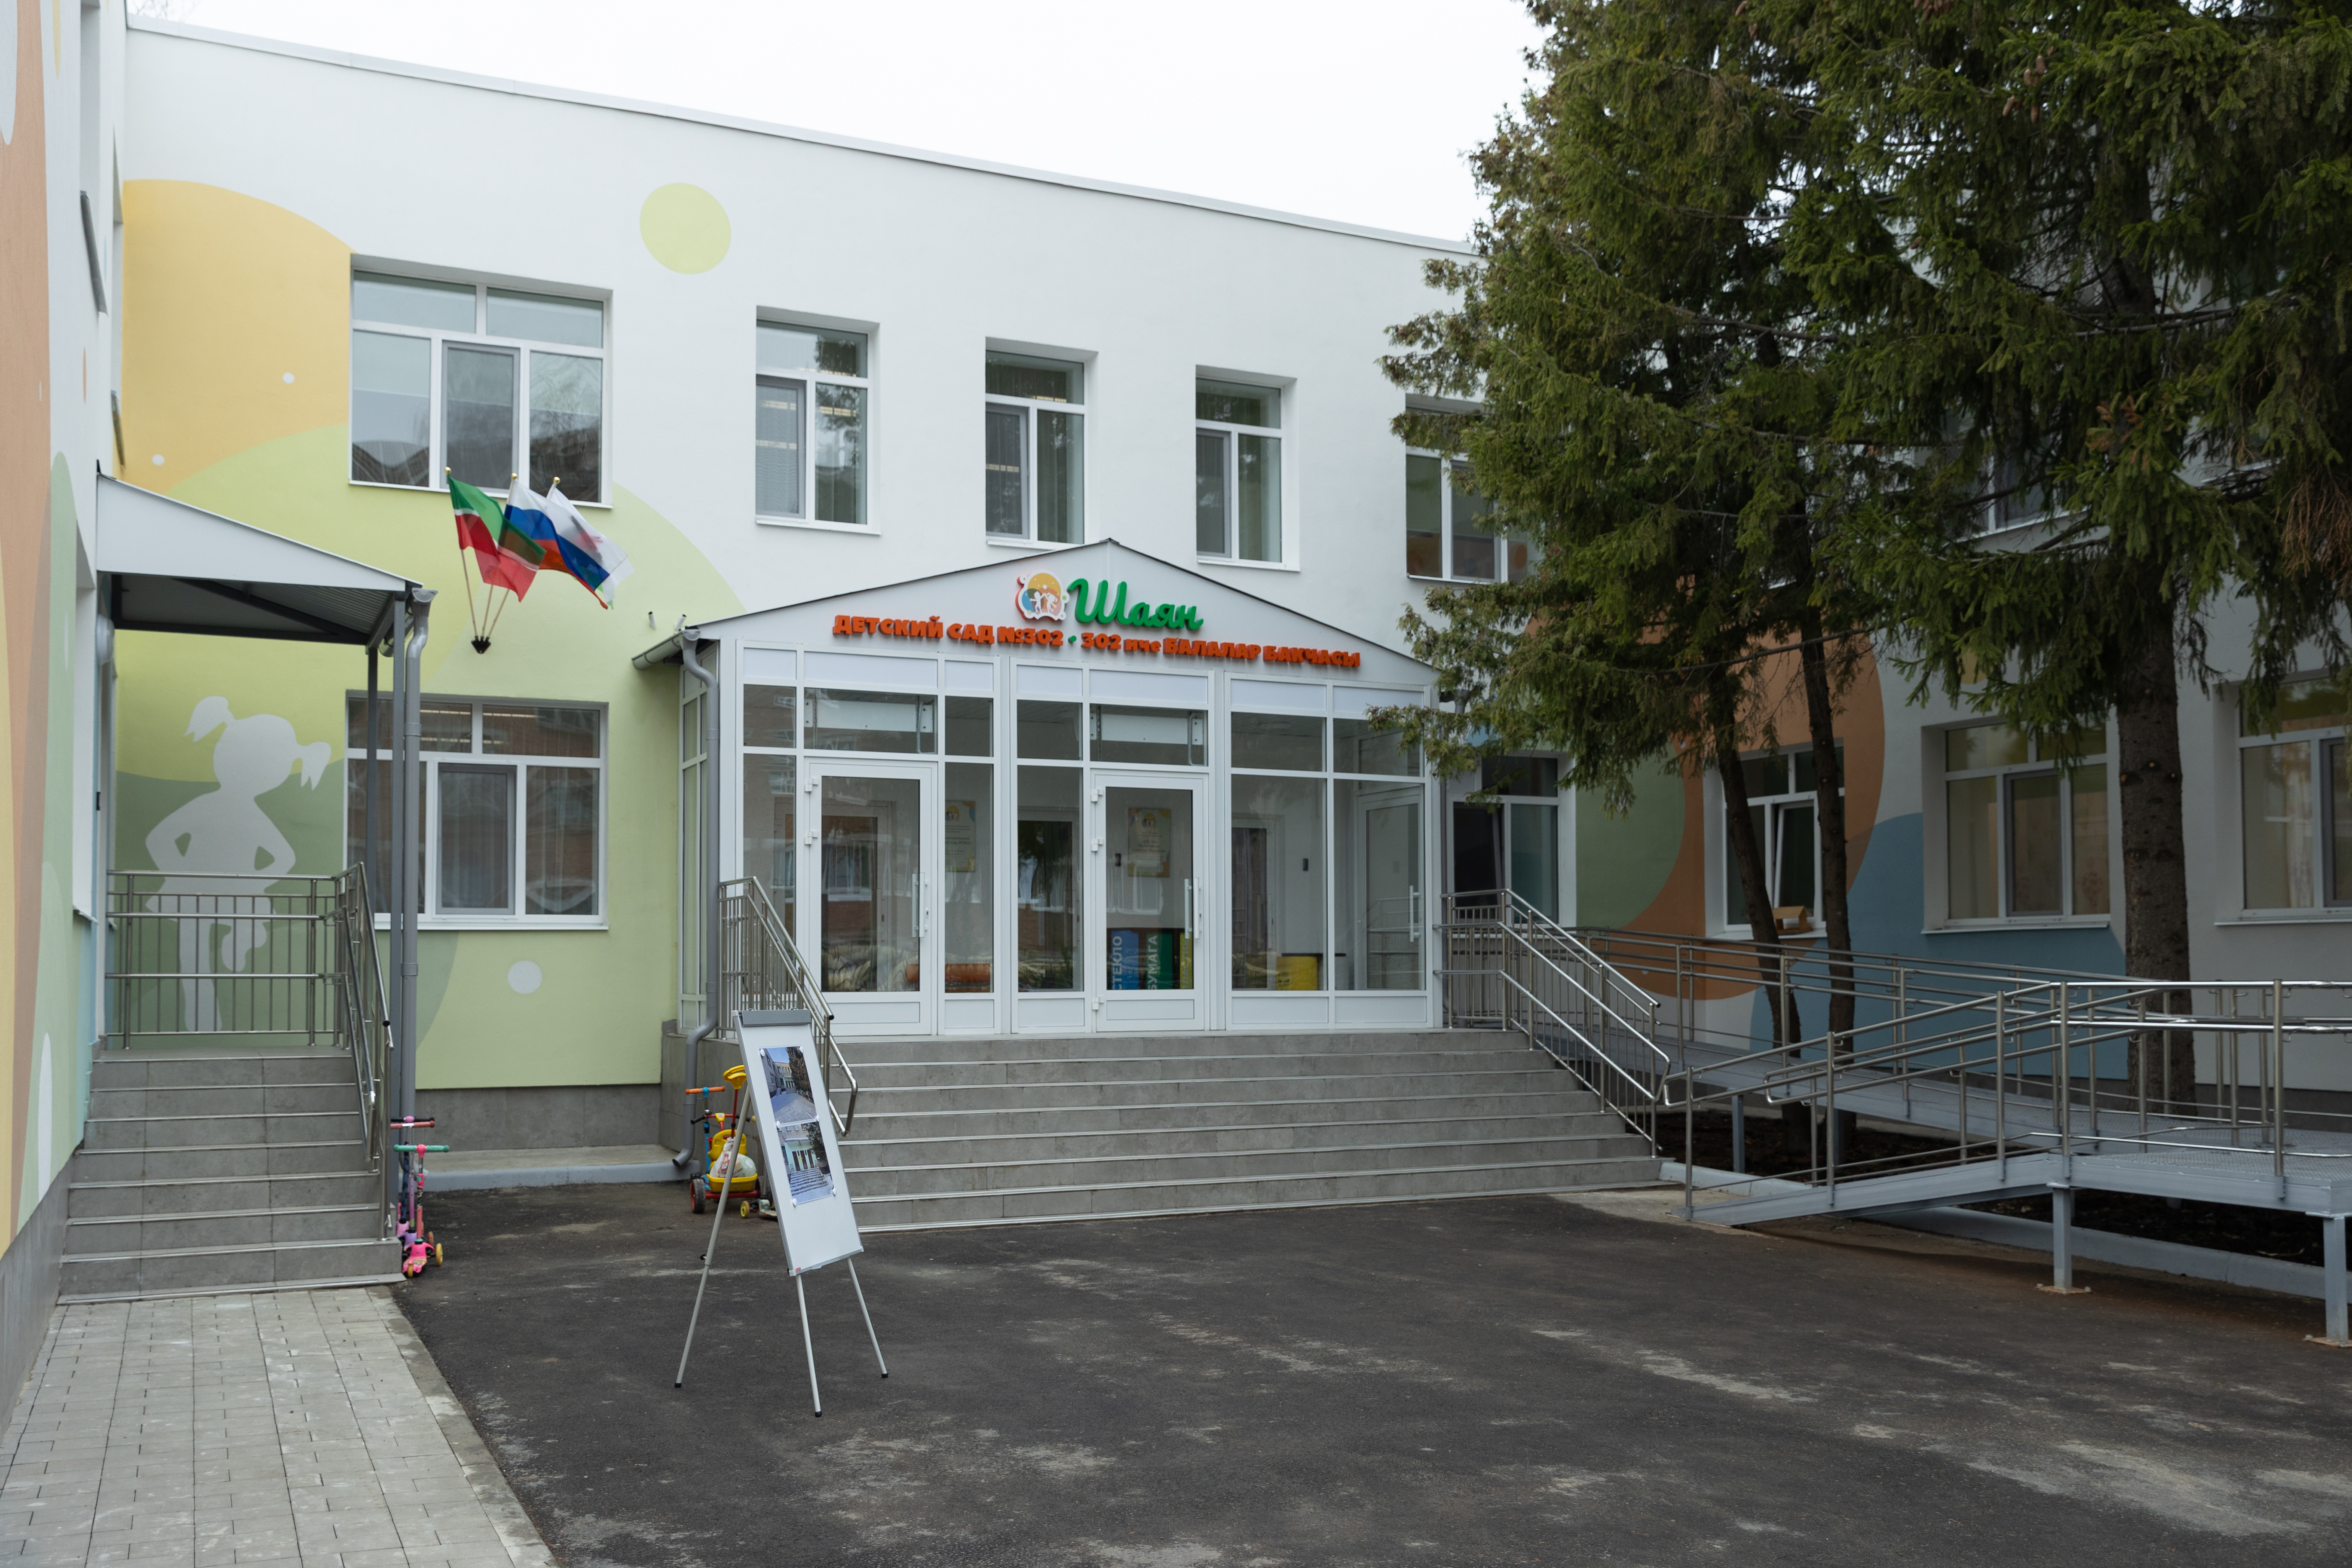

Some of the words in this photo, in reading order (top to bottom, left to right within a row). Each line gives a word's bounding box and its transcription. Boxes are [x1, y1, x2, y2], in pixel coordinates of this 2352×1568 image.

[1067, 578, 1204, 630] Шаян
[833, 615, 943, 638] ДЕТСКИЙ
[946, 623, 995, 644] САД
[997, 626, 1064, 646] №302
[1081, 632, 1121, 650] 302
[1123, 637, 1161, 652] нче
[1162, 637, 1262, 659] БАЛАЛАР
[1262, 645, 1360, 667] БАКЧАСЫ
[1112, 936, 1122, 989] СТЕКЛО
[1148, 935, 1158, 989] БУМАГА
